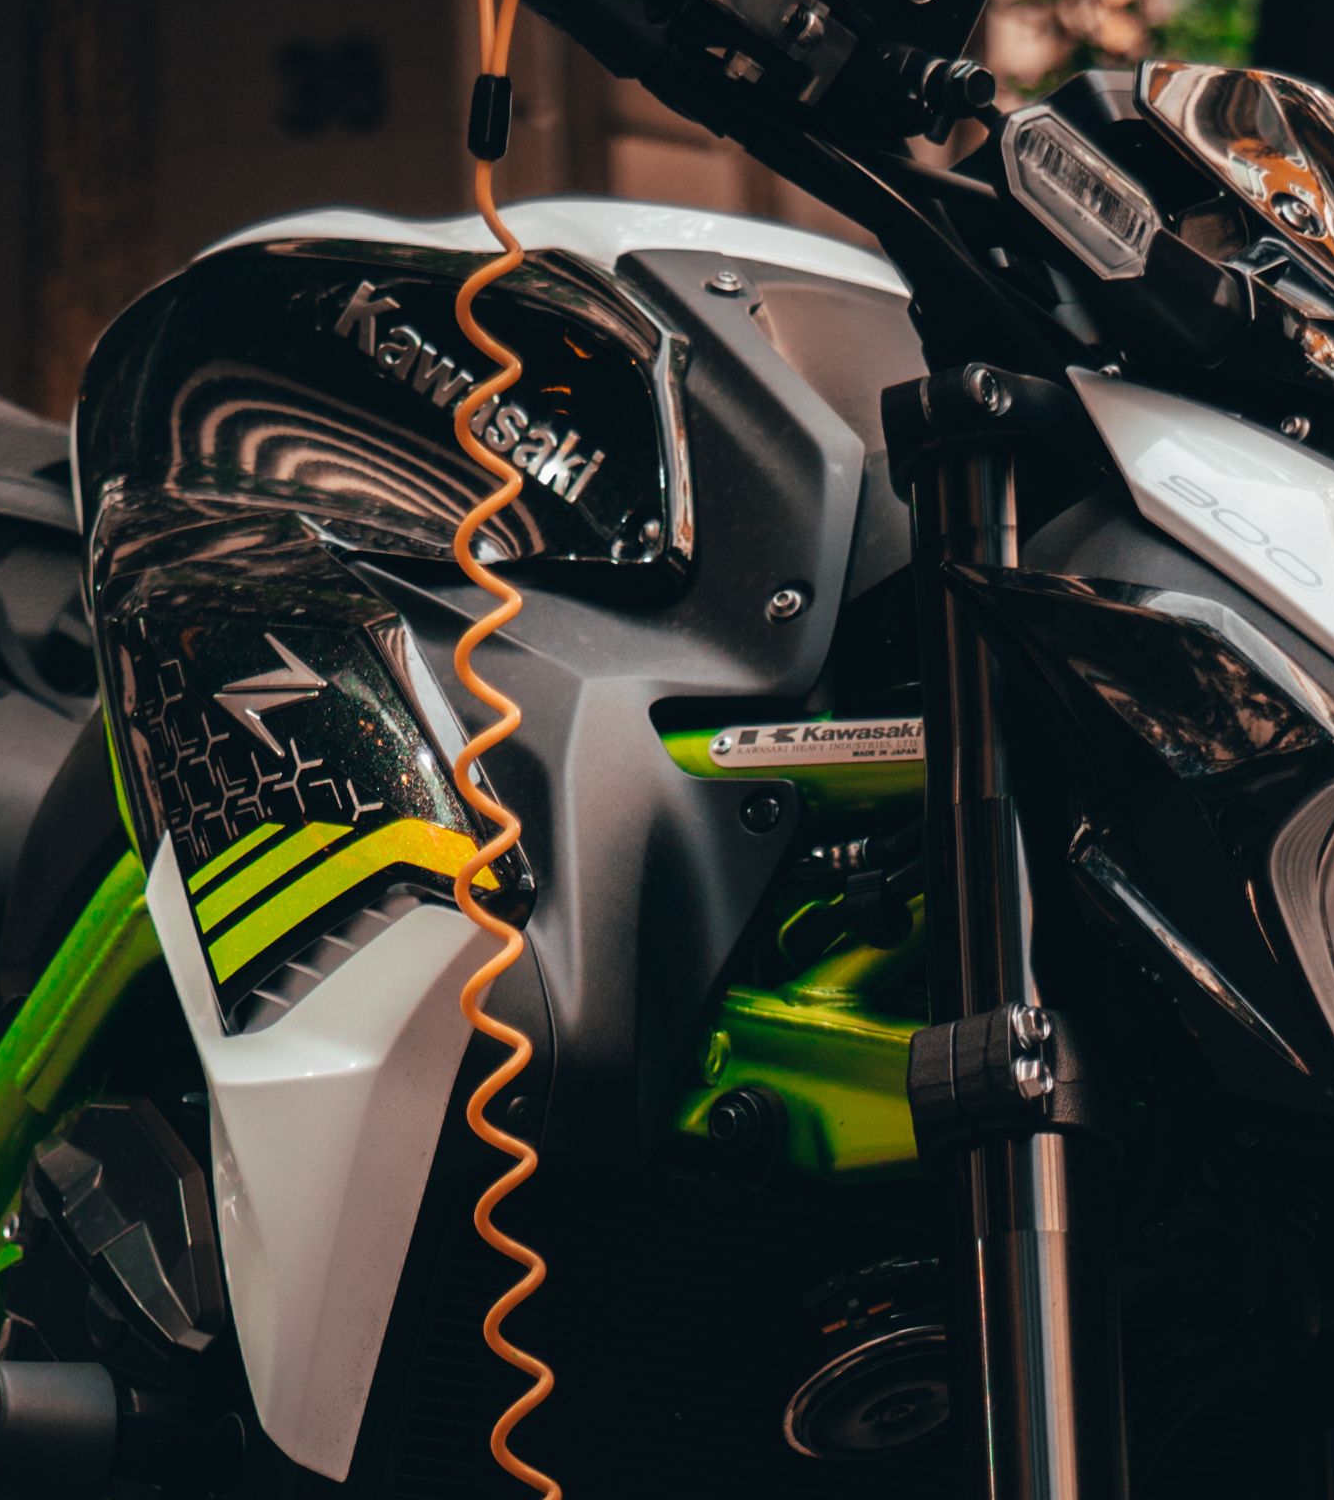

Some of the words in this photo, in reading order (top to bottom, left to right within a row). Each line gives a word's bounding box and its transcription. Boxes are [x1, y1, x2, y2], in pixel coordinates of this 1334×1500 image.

[335, 281, 606, 502] Kawasaki
[1155, 473, 1324, 589] 900
[802, 722, 923, 741] Kawasaki
[852, 749, 876, 757] MADE
[890, 748, 917, 756] JAPAN
